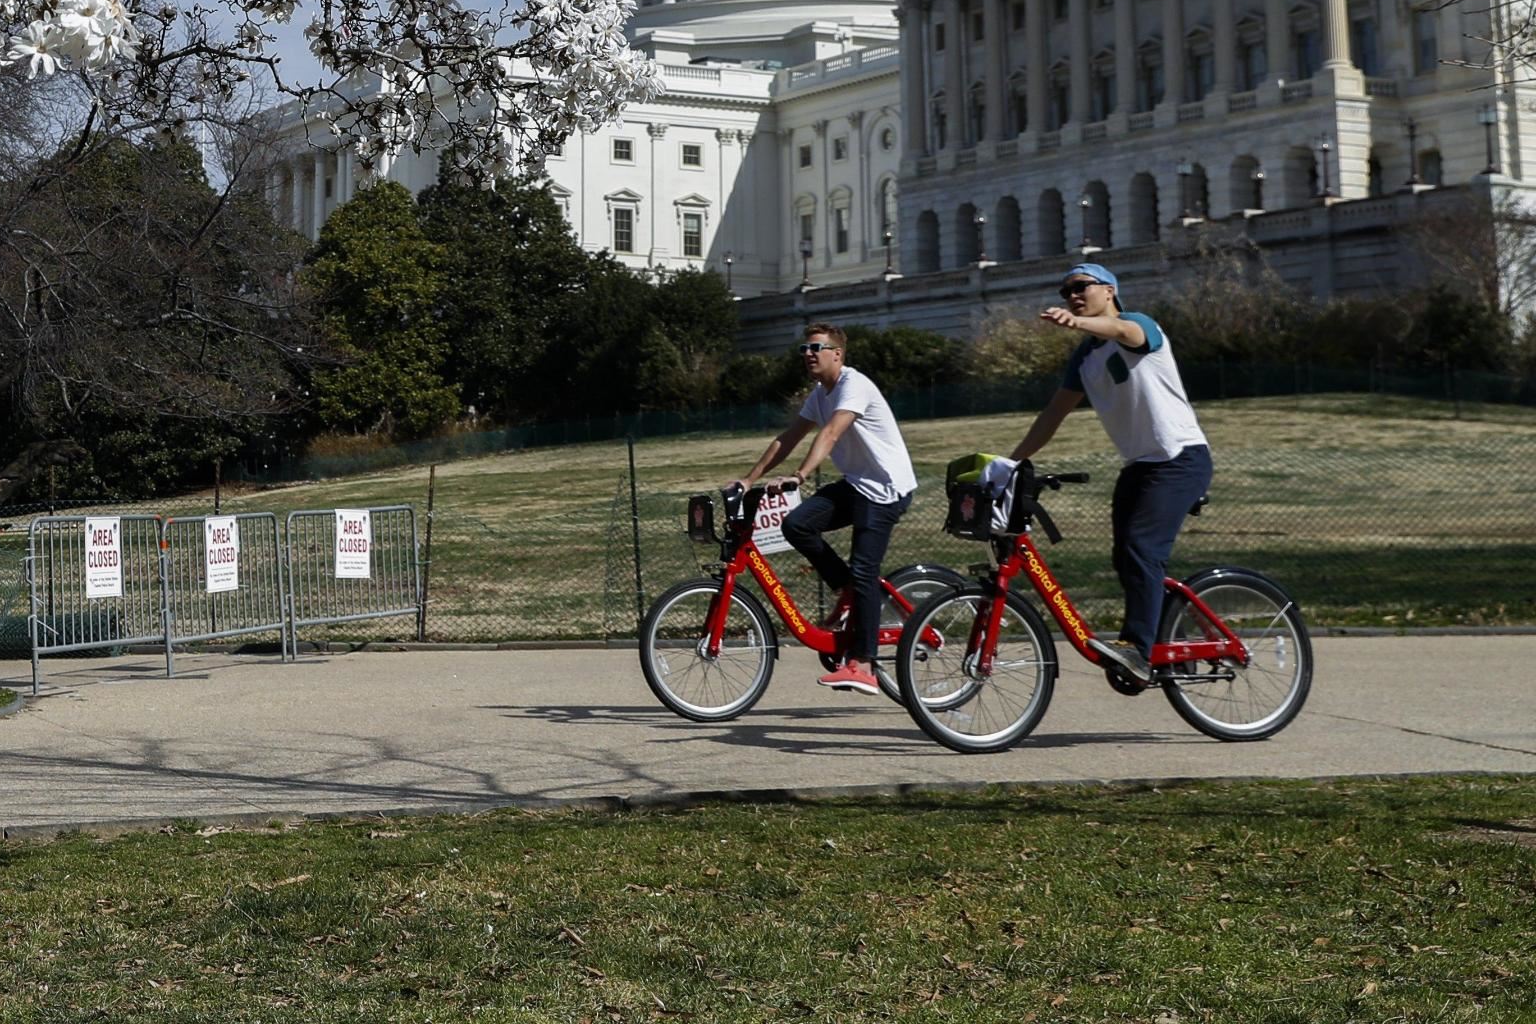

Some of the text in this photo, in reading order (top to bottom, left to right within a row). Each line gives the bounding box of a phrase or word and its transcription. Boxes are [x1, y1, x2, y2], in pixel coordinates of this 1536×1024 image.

[757, 493, 789, 512] REA
[212, 528, 231, 545] AREA
[344, 520, 364, 535] AREA
[92, 529, 114, 547] AREA
[339, 538, 368, 553] CLOSED
[88, 550, 118, 568] CLOSED
[209, 547, 235, 565] CLOSED
[749, 550, 777, 586] capital
[773, 584, 806, 634] bikeshare
